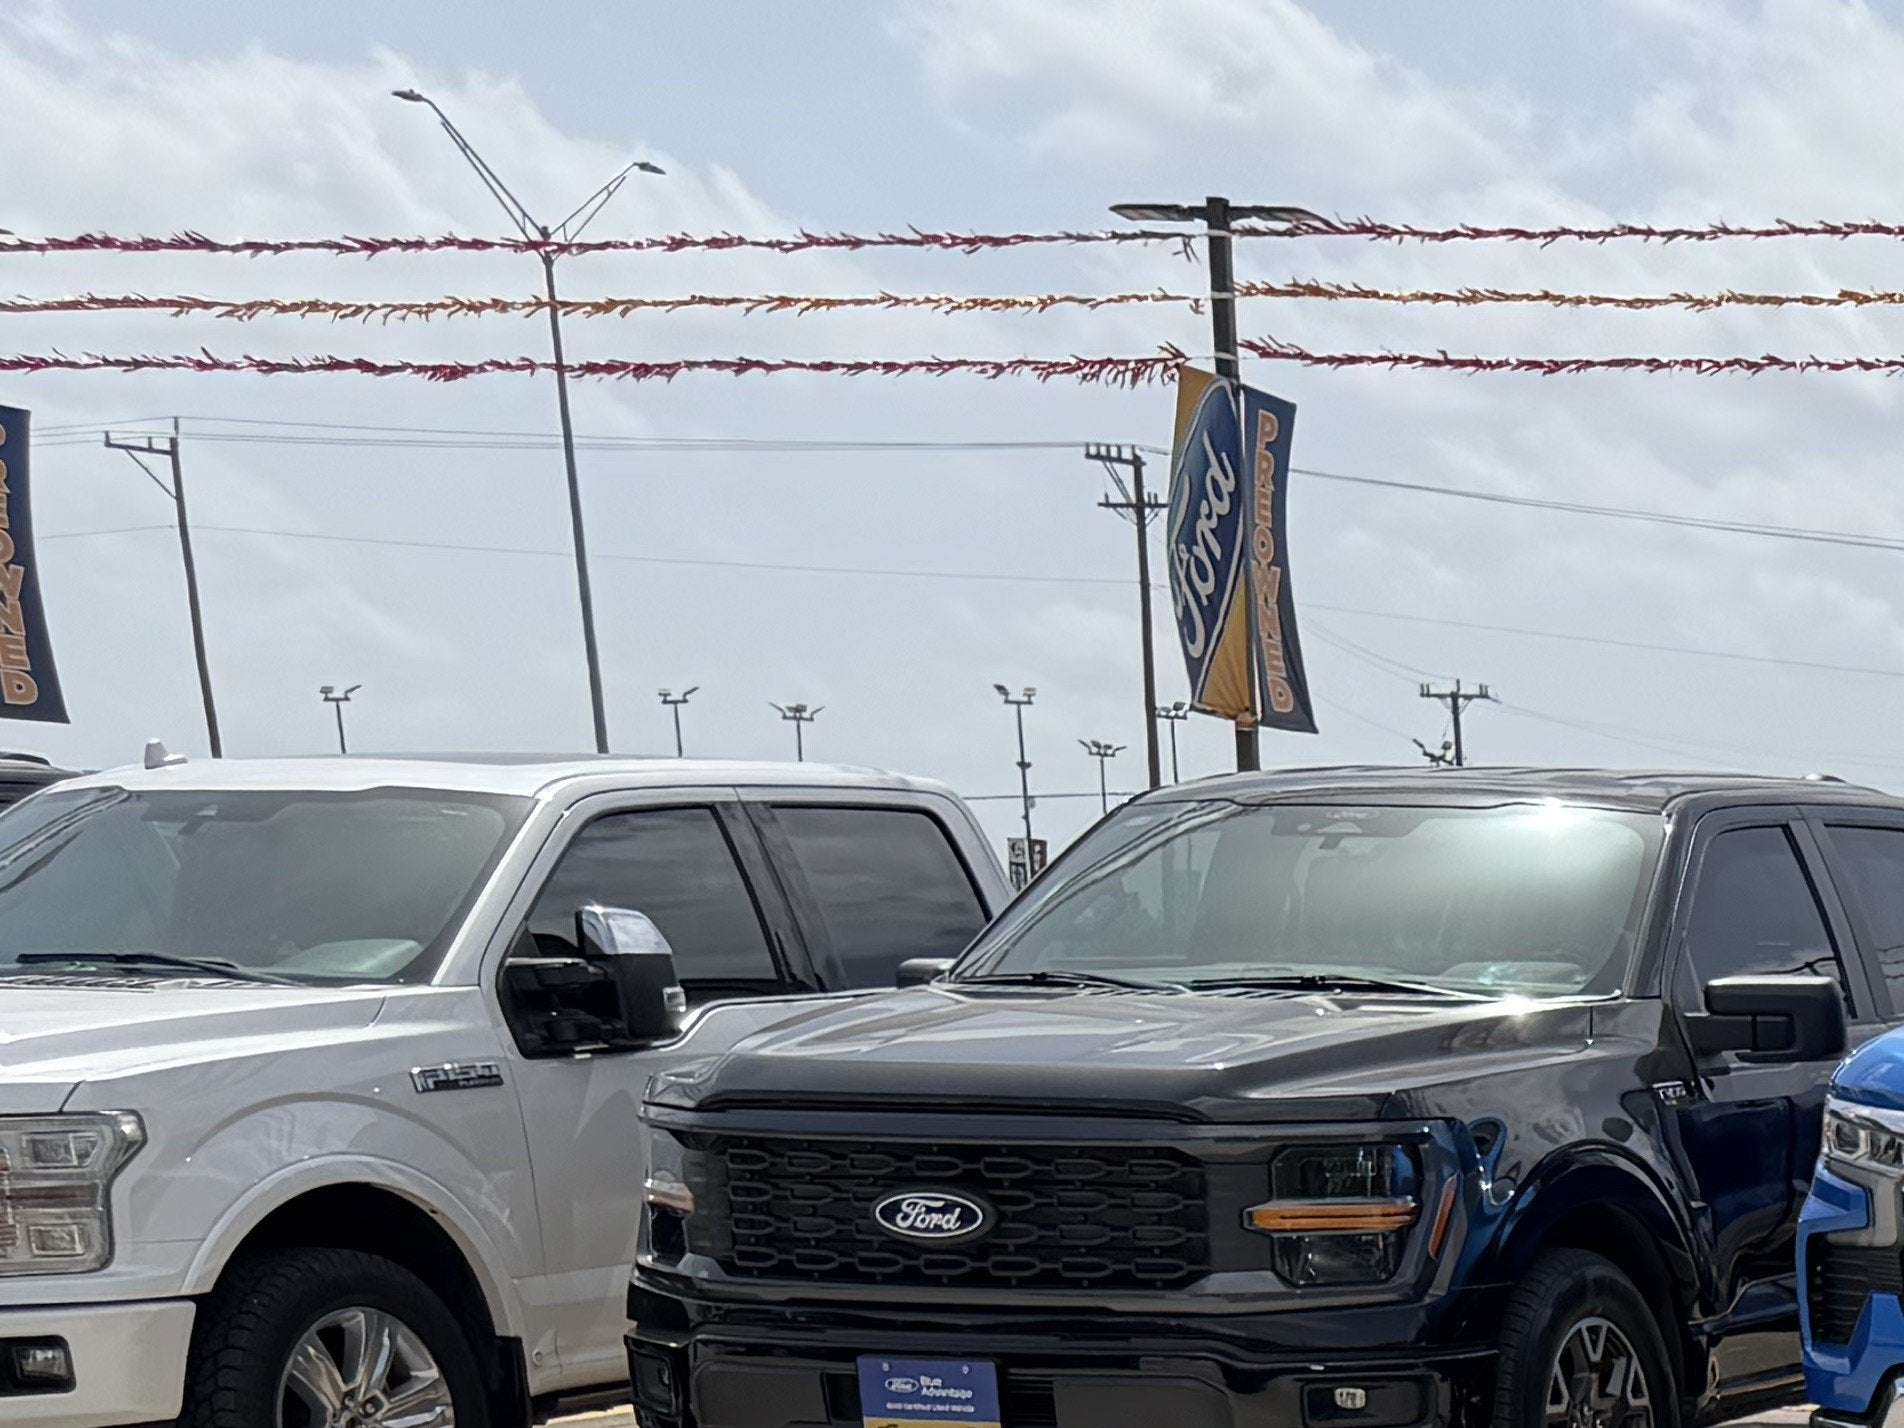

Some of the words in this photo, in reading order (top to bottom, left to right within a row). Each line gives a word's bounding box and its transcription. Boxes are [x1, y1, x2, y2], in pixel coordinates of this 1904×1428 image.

[1171, 430, 1237, 659] Ford
[1252, 410, 1294, 713] PREOWNED
[896, 1198, 961, 1230] Ford
